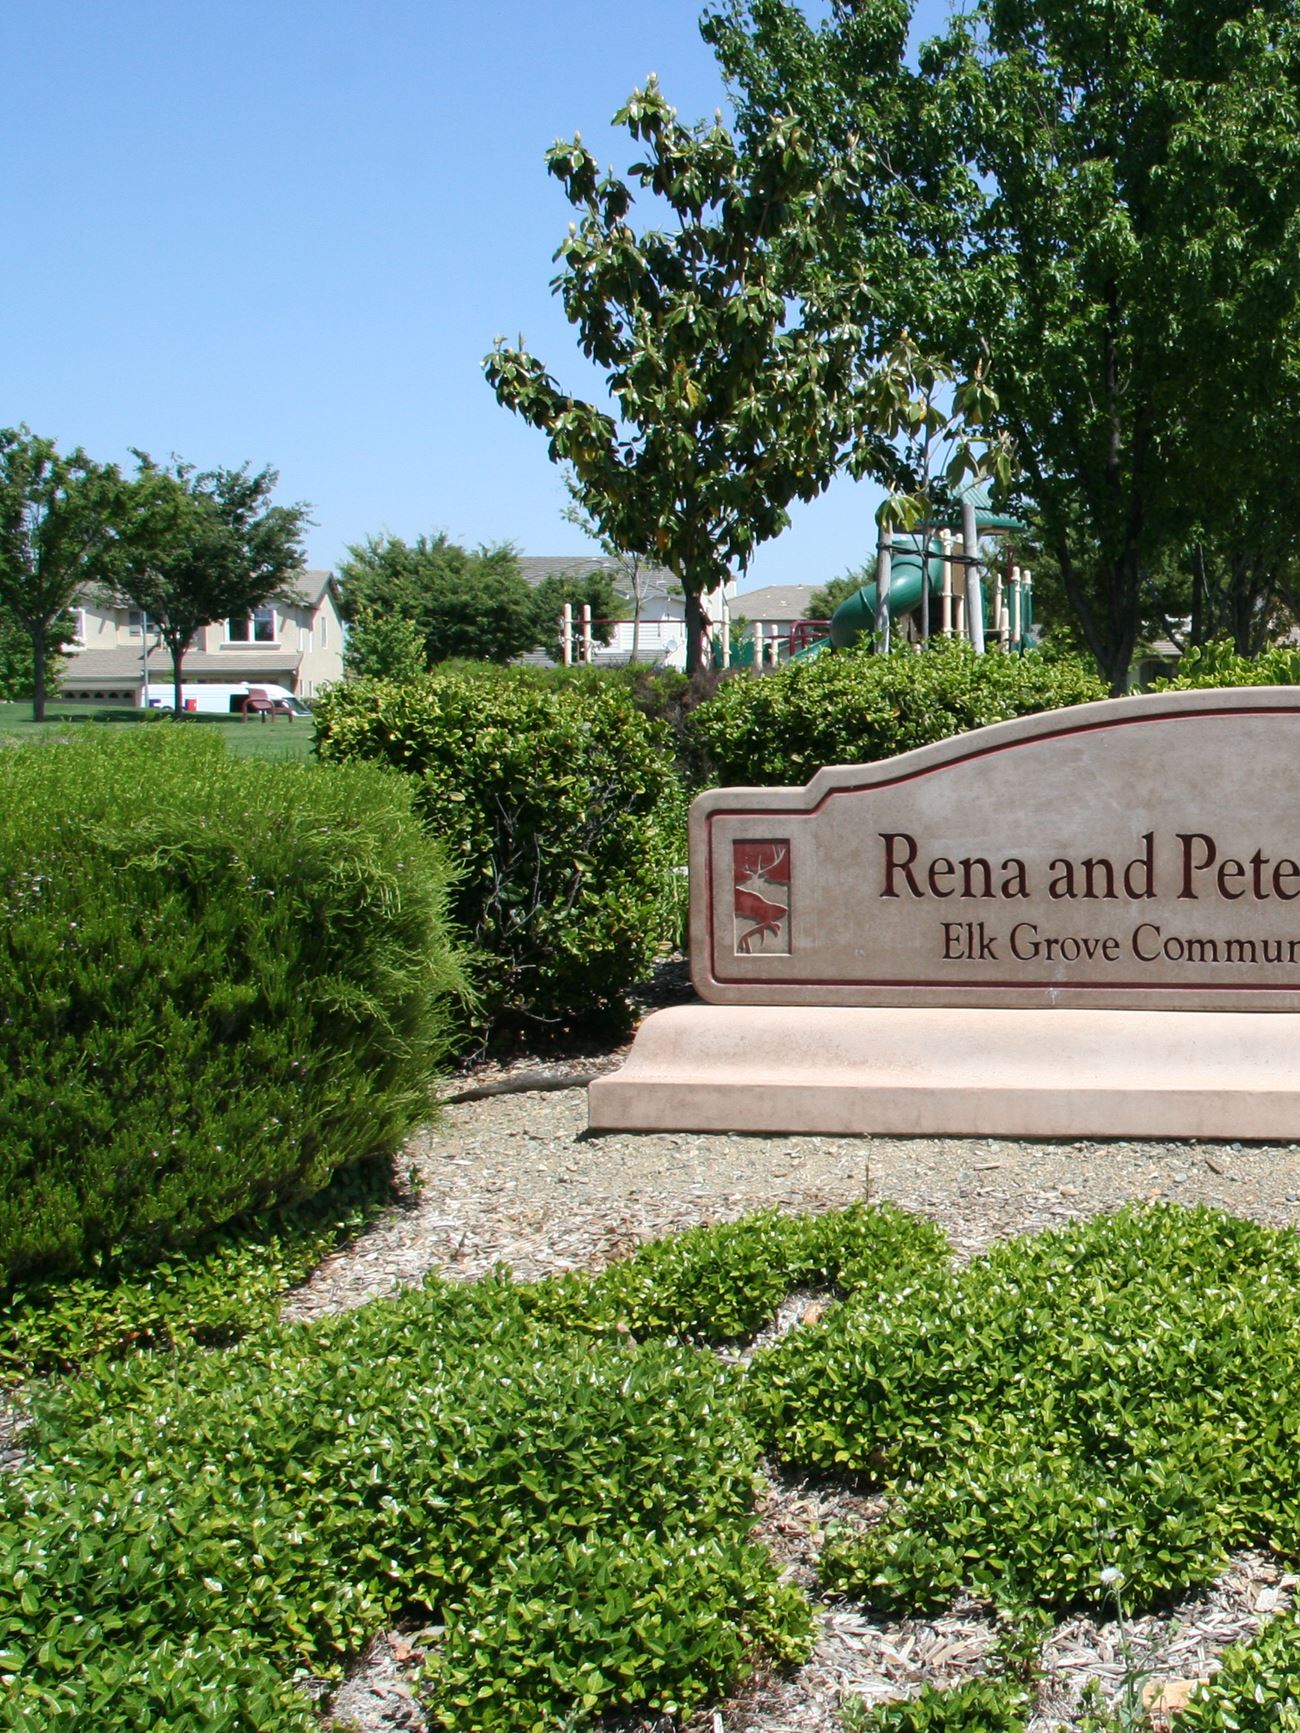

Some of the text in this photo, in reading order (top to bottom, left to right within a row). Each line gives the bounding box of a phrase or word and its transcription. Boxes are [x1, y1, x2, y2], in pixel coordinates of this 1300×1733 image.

[878, 832, 1032, 900] Rena
[1049, 830, 1158, 900] and
[940, 921, 1000, 961] Elk
[1010, 921, 1121, 962] Grove
